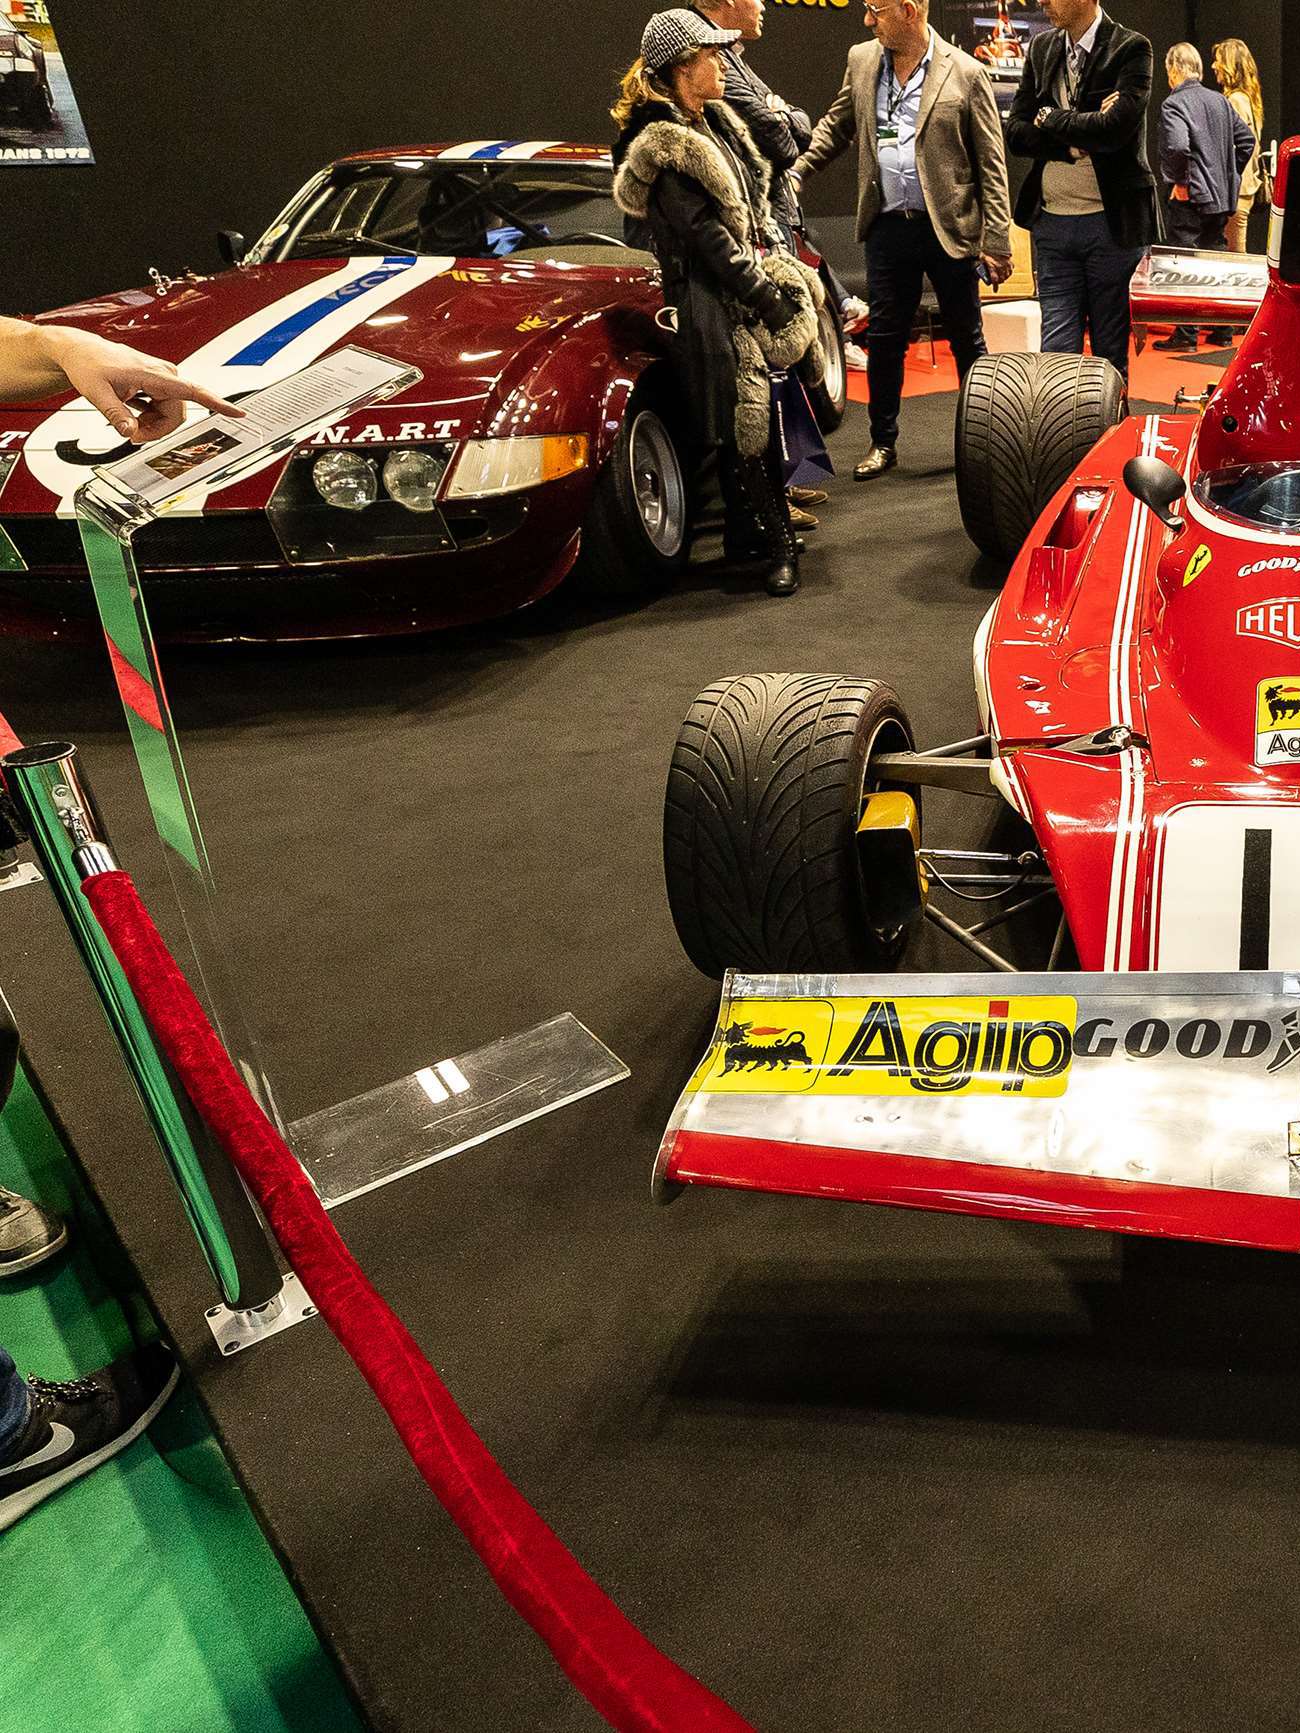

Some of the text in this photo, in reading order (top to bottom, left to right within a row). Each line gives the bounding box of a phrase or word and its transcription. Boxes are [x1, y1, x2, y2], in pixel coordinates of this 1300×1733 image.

[0, 148, 41, 160] ANS
[826, 1000, 1073, 1092] Agip
[1072, 1018, 1272, 1058] GOOD
